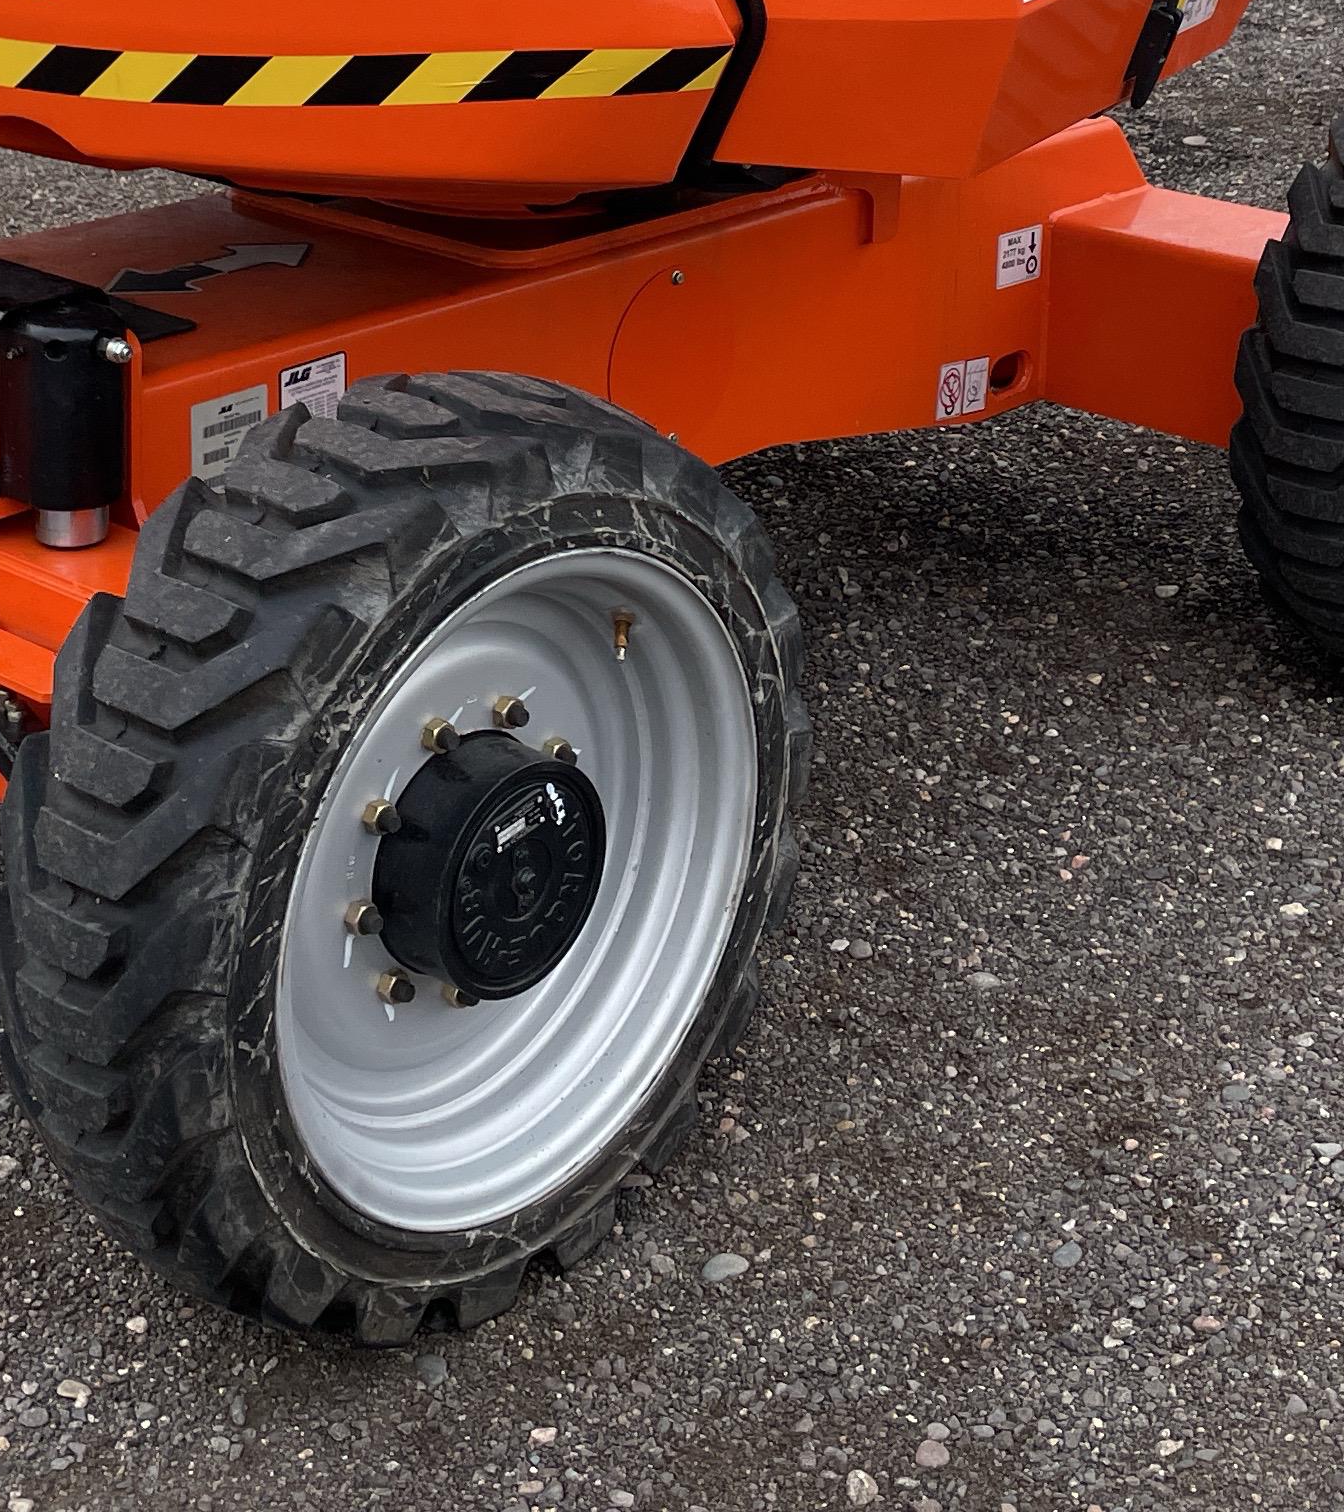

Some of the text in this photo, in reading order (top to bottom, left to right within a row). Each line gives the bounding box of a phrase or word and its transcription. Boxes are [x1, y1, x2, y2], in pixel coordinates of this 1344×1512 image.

[1008, 236, 1022, 246] MAX
[283, 366, 313, 388] JLG
[217, 403, 234, 415] JLG
